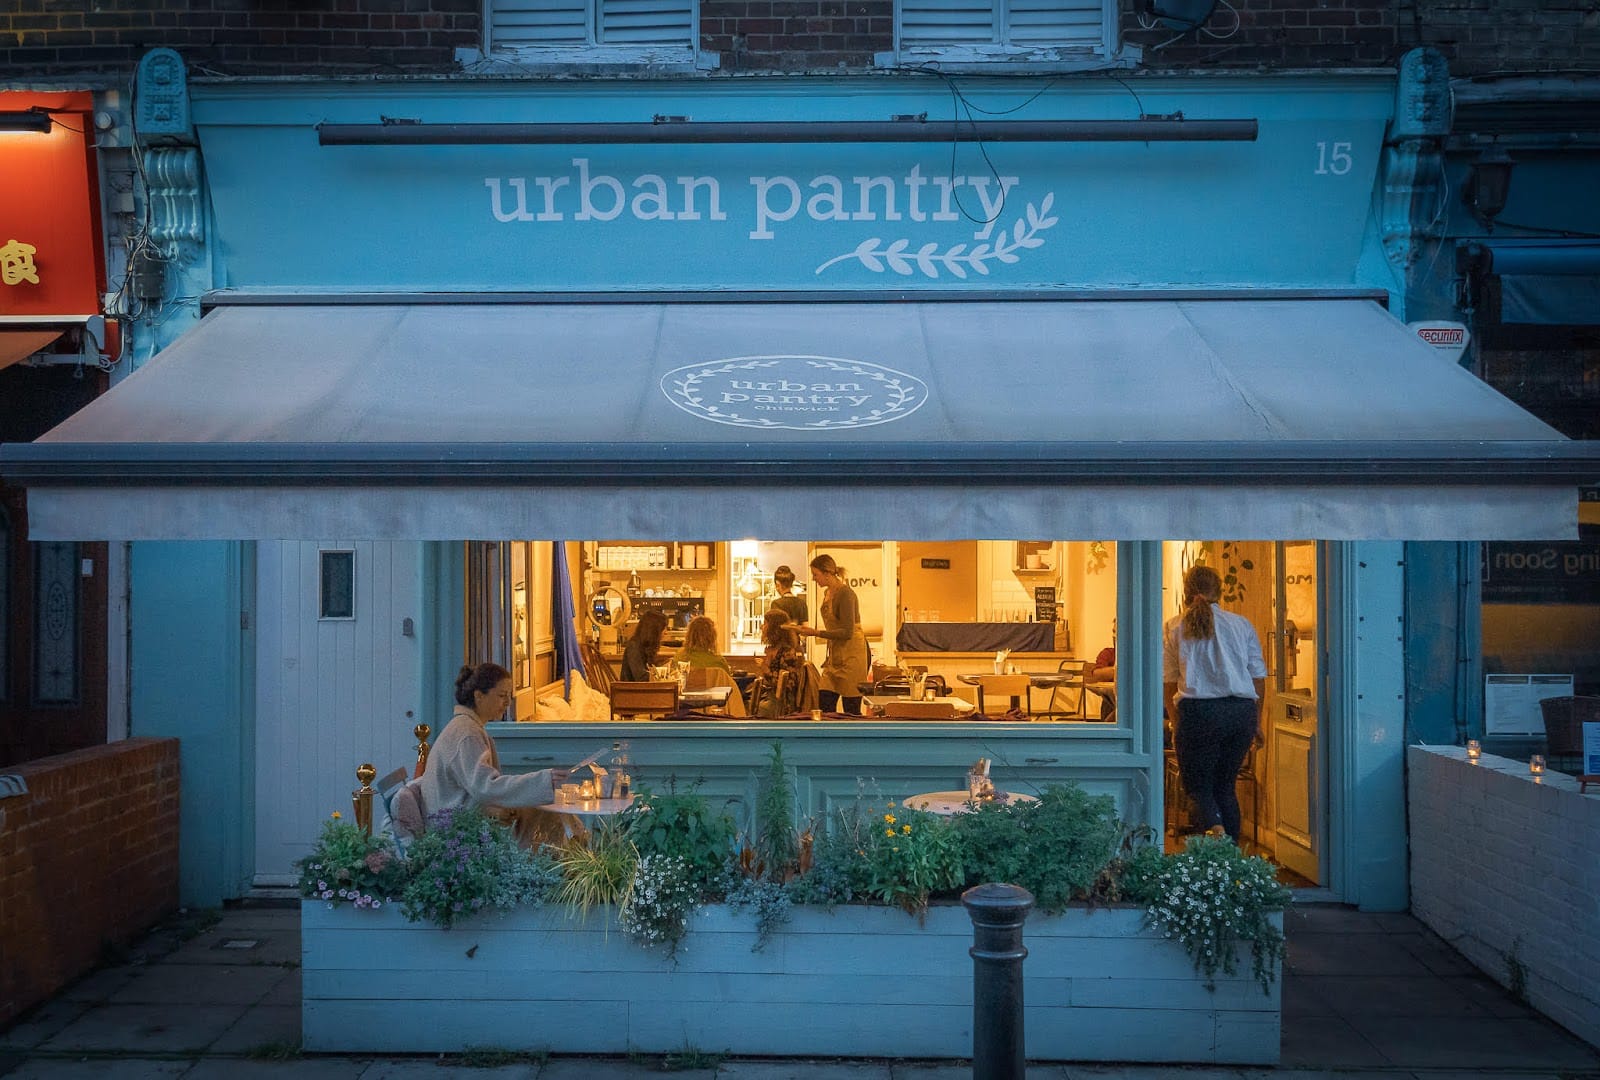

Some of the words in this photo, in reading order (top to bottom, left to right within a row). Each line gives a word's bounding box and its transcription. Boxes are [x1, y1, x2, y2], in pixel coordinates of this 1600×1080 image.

[1314, 142, 1352, 175] 15
[484, 158, 726, 222] urban
[749, 162, 1019, 240] pantry
[730, 380, 864, 391] urban
[719, 392, 872, 406] pantry
